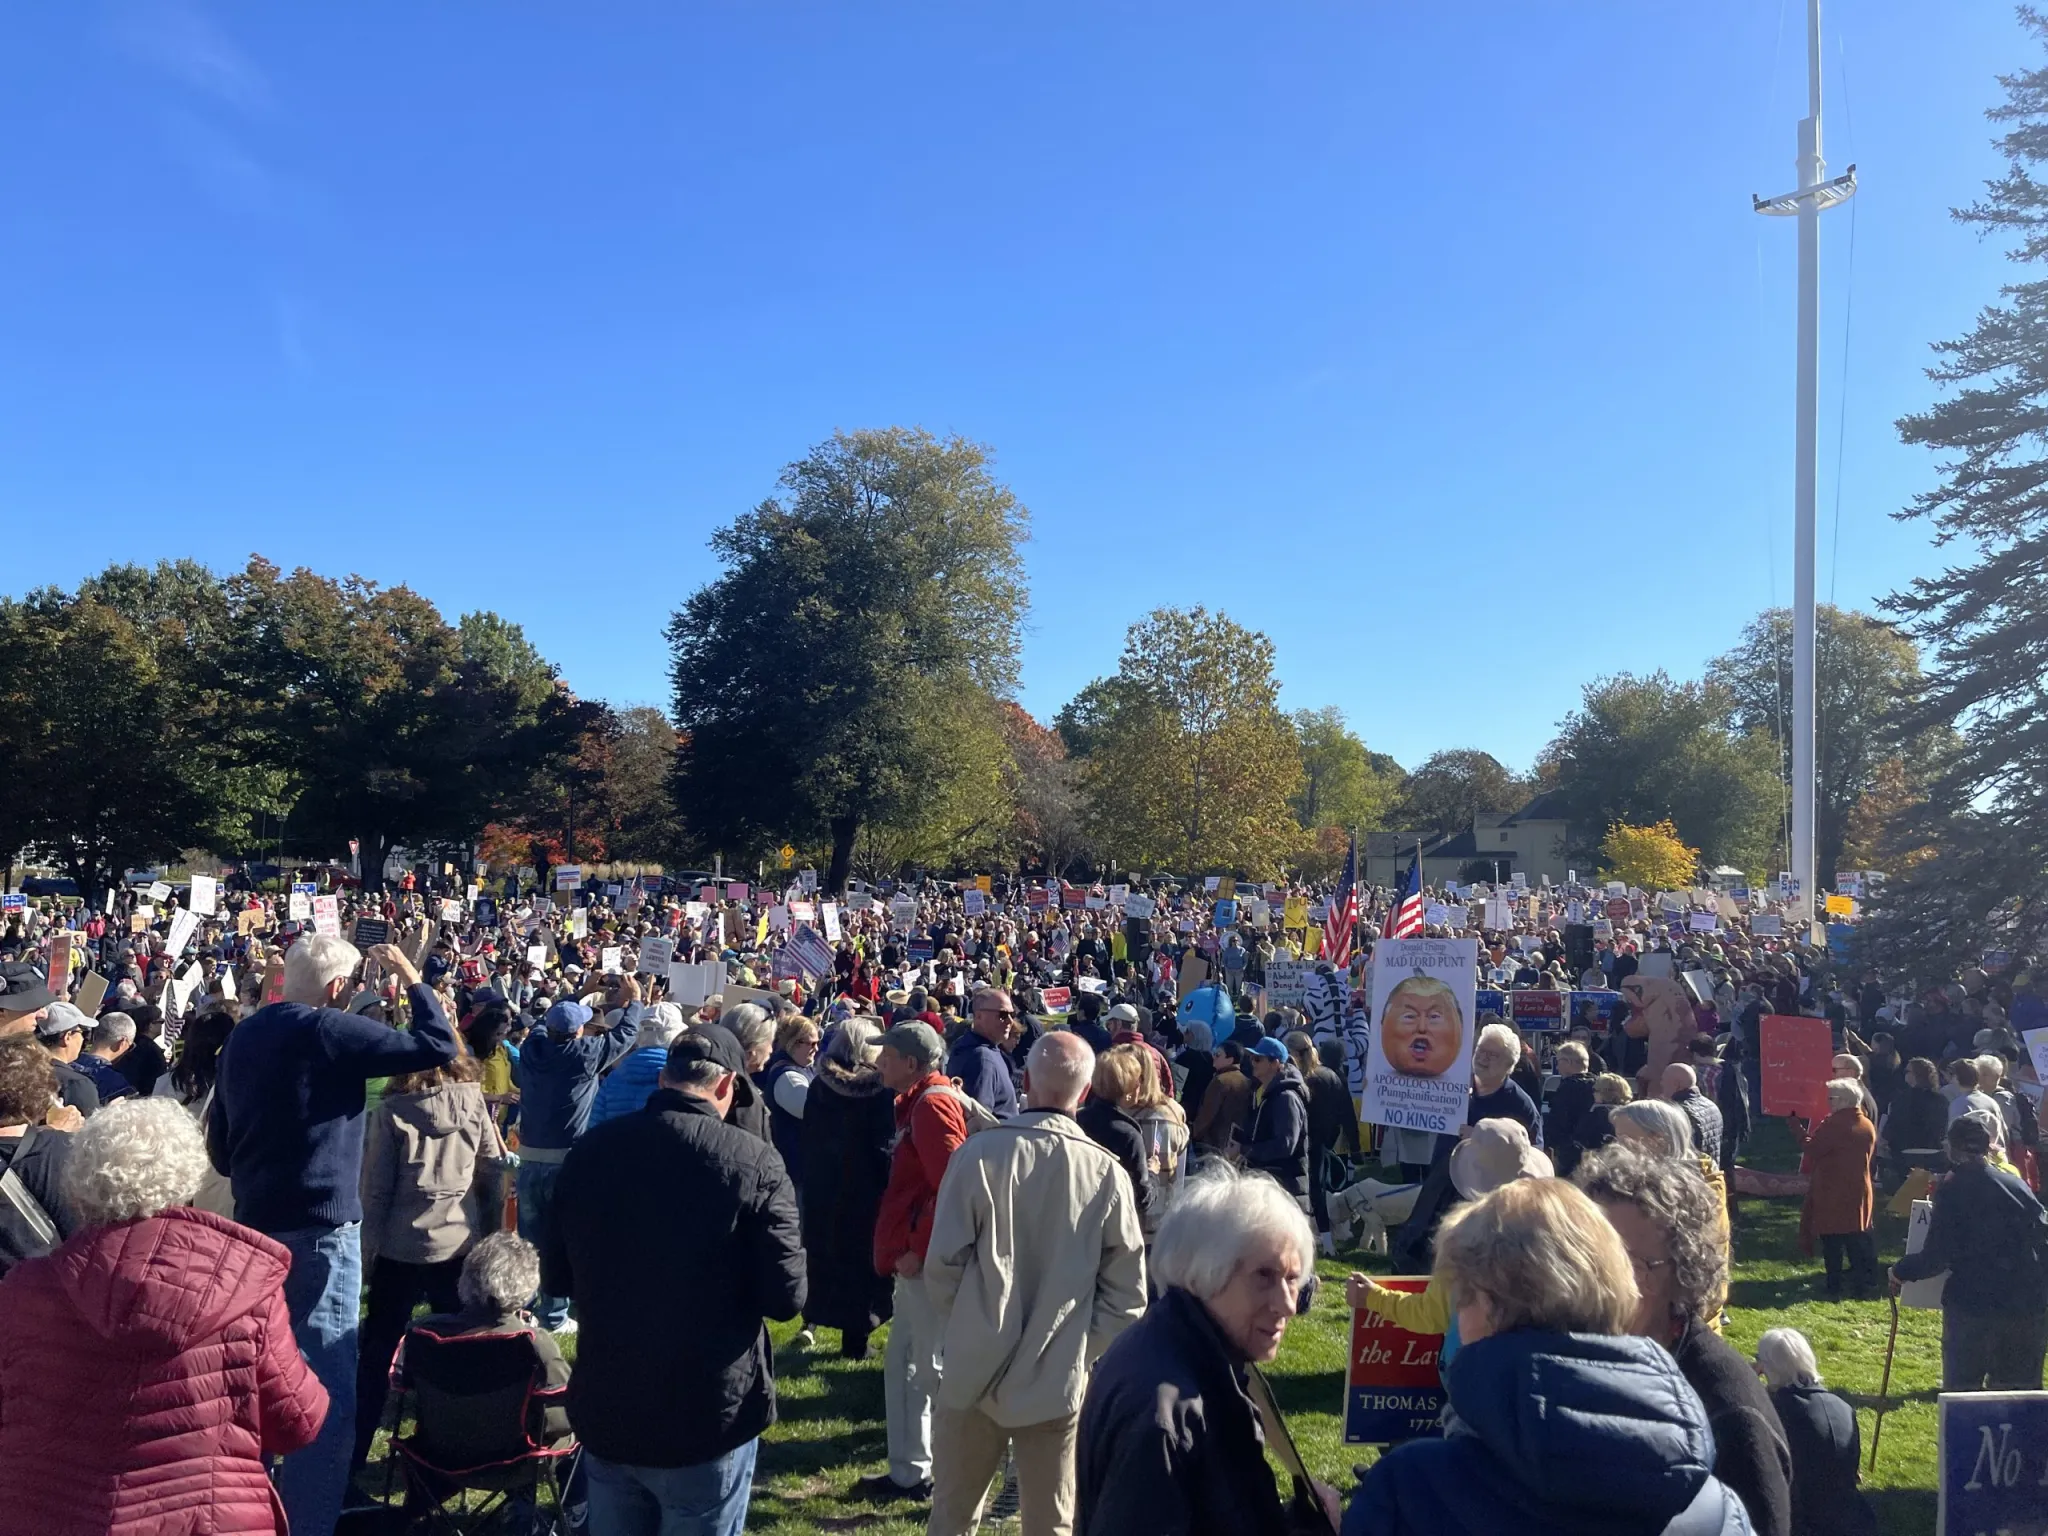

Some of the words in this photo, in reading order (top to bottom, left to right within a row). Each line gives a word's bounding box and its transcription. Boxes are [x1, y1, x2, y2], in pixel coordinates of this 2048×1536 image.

[1401, 943, 1422, 951] Donald
[1424, 943, 1446, 953] Trump
[1266, 962, 1281, 970] ICE
[1386, 957, 1407, 967] MAD
[1410, 957, 1436, 967] LORD
[1437, 957, 1465, 967] PUNT
[1273, 971, 1296, 980] Abduct
[1273, 981, 1292, 991] Deny
[1373, 1074, 1469, 1094] APOCOLOCYNTOSIS
[1377, 1085, 1462, 1107] (Pumpkinification)
[1411, 1102, 1441, 1114] November
[1385, 1108, 1403, 1125] NO
[1406, 1111, 1447, 1131] KINGS
[1359, 1340, 1392, 1365] the
[1359, 1394, 1437, 1411] THOMAS
[1963, 1422, 2021, 1491] No
